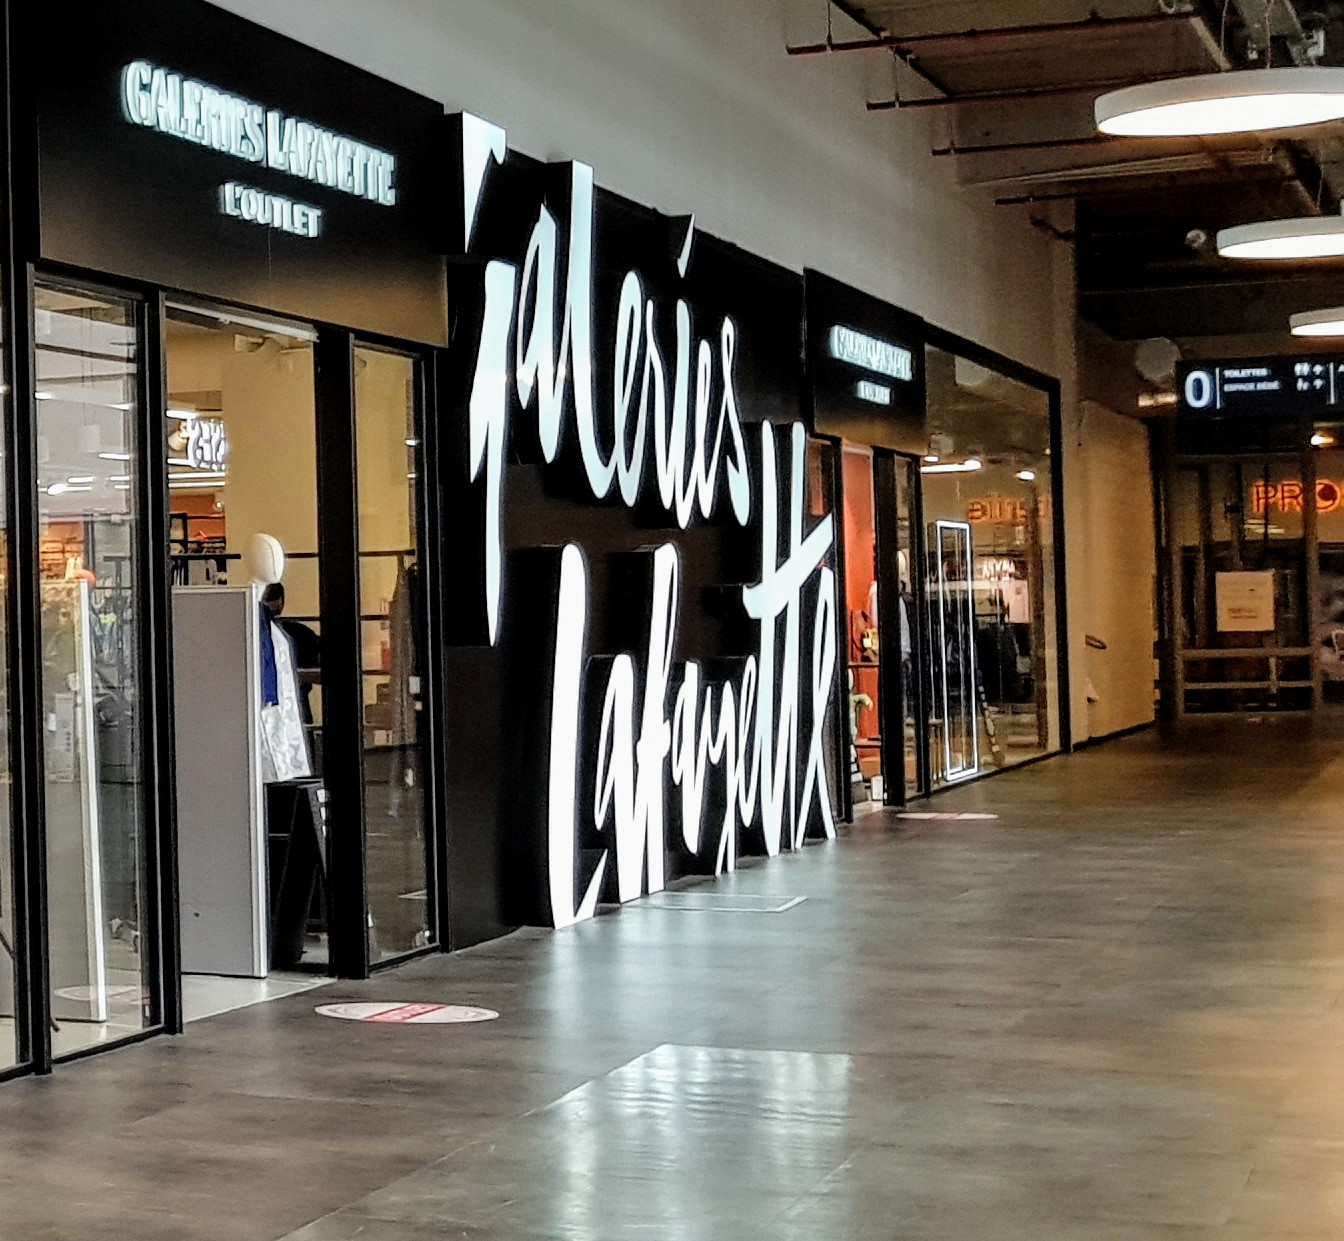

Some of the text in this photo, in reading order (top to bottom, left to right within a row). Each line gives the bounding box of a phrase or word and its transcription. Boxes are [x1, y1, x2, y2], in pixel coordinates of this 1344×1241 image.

[121, 60, 396, 206] GALERIES LAFAYETTE
[220, 181, 322, 238] L'OUTLET
[1185, 370, 1211, 408] 0
[1253, 479, 1344, 513] PRO
